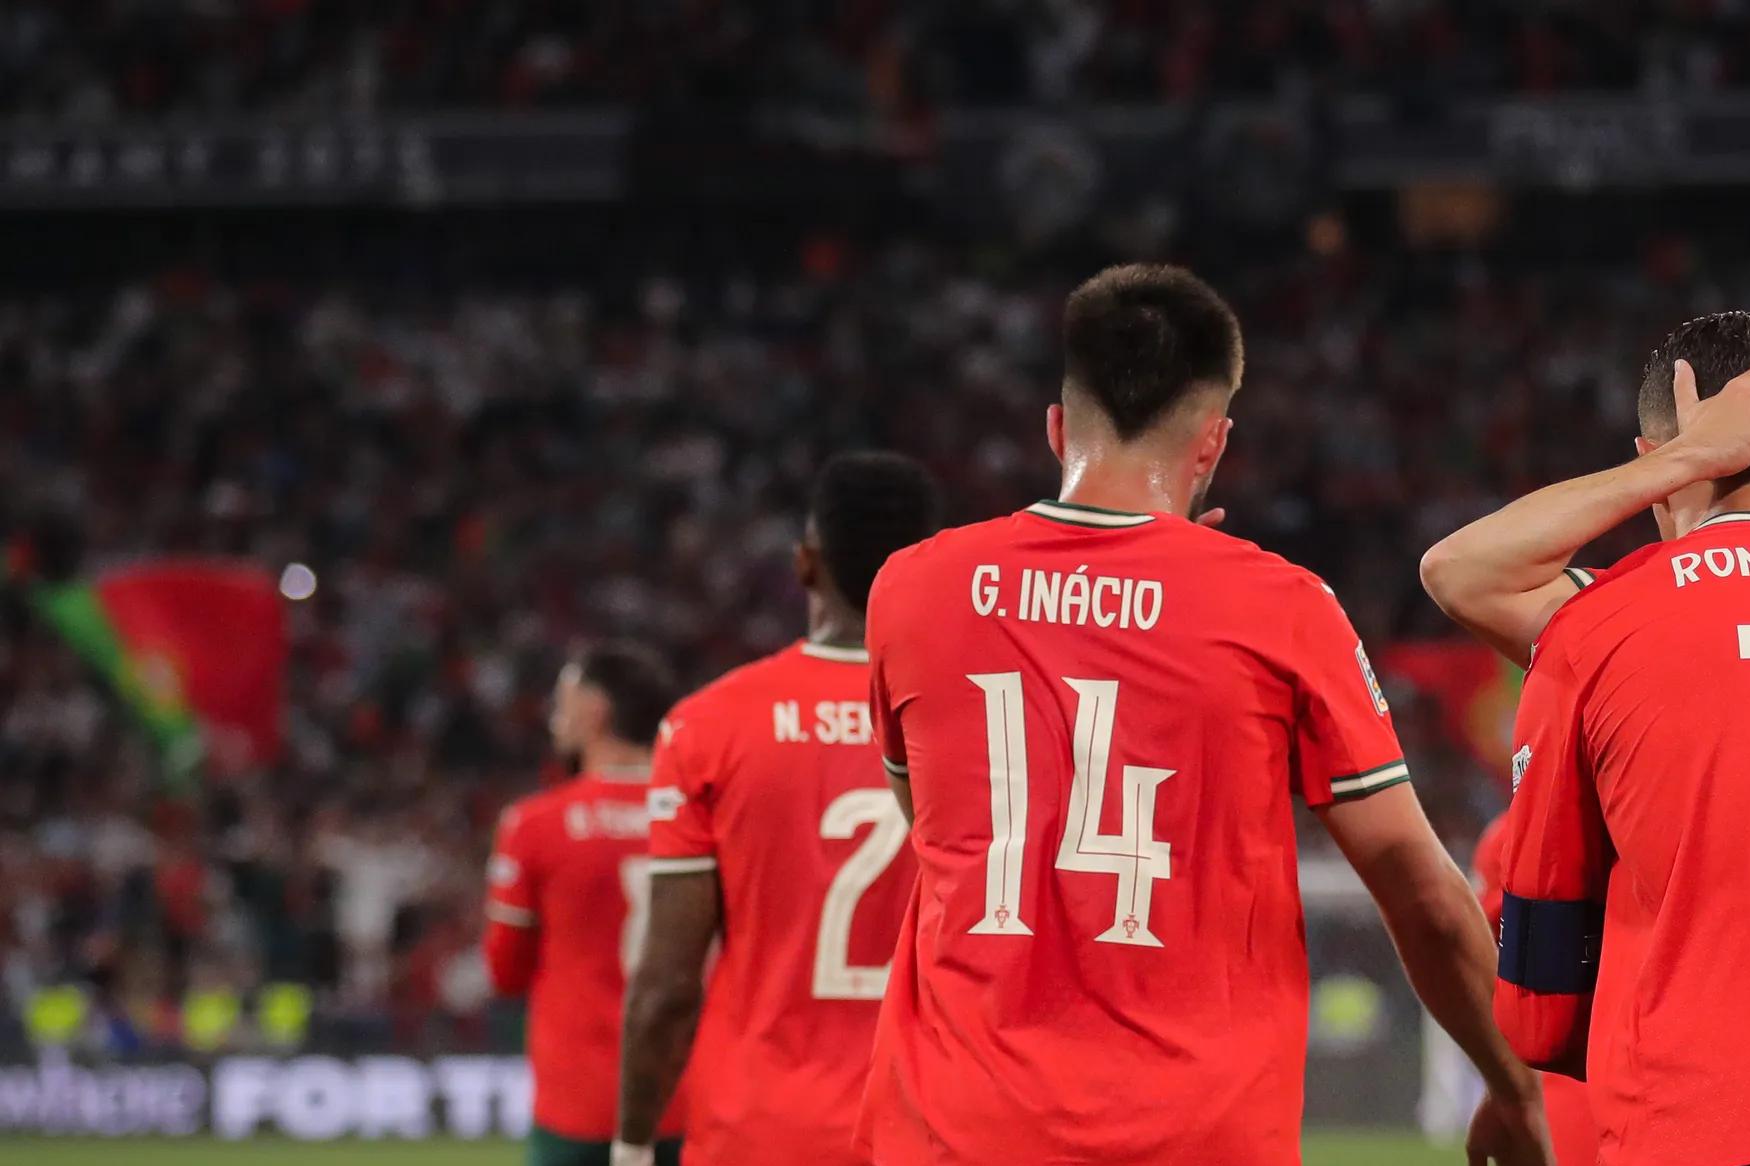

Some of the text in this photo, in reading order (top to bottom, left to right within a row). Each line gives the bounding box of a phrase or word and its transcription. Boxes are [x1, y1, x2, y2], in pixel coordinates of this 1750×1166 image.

[971, 564, 1163, 631] G. INÁCIO
[773, 700, 810, 743] N.
[965, 671, 1178, 948] 14
[812, 787, 912, 999] 2
